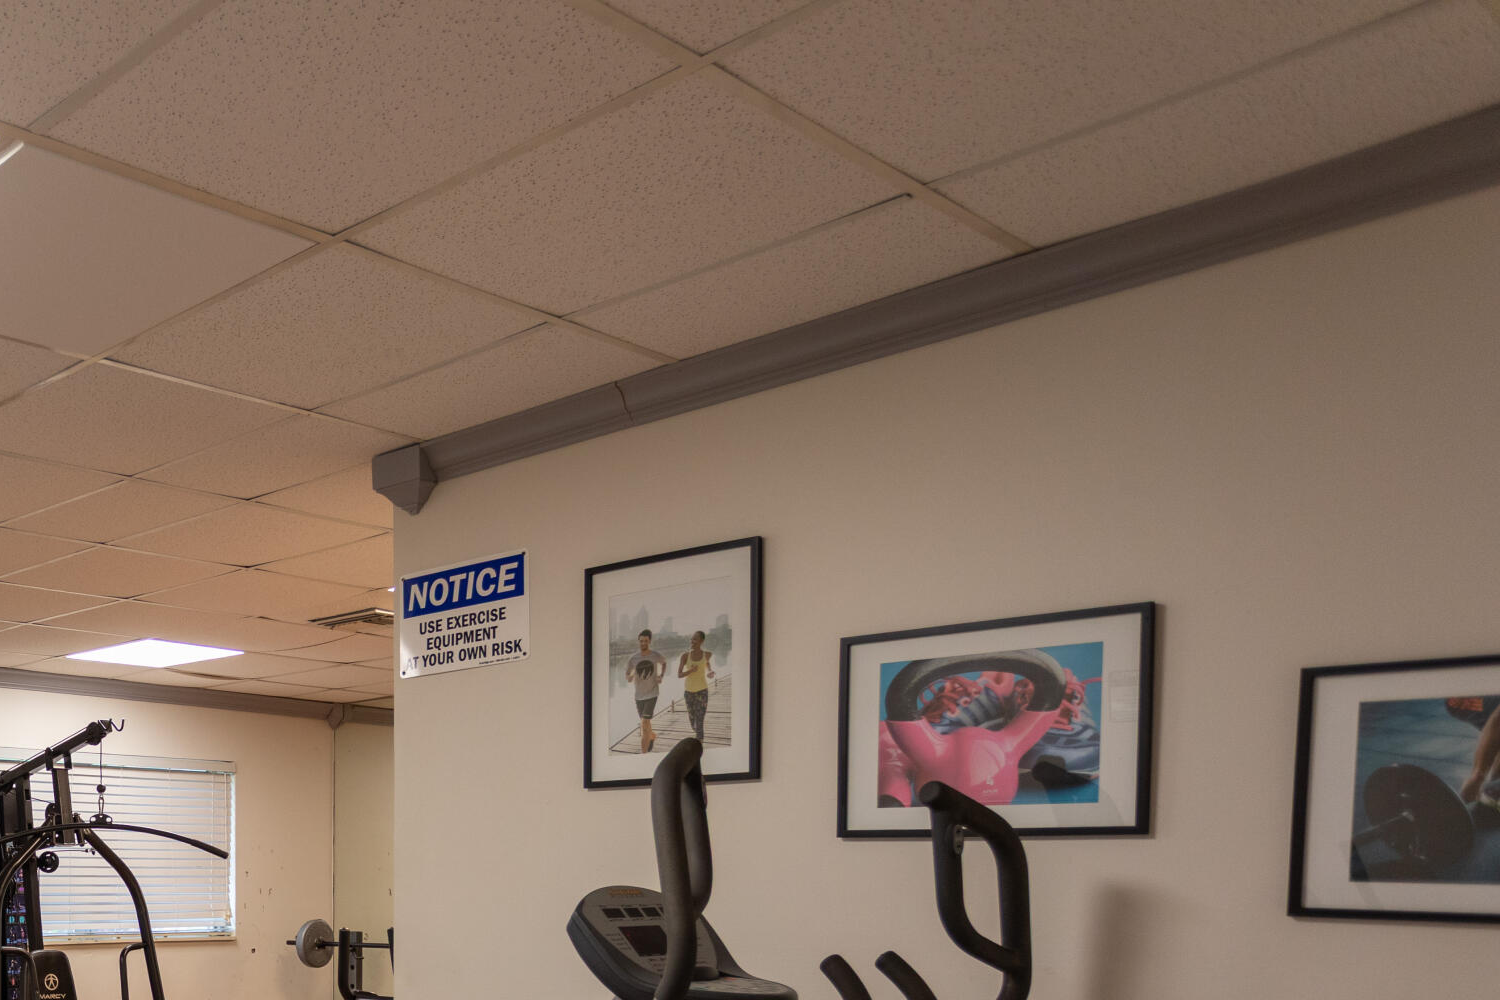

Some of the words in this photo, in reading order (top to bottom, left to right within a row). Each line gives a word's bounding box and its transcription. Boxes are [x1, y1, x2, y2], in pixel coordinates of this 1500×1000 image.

[408, 561, 519, 612] NOTICE
[419, 619, 443, 635] USE
[446, 606, 507, 631] EXERCISE
[426, 626, 498, 651] EQUIPMENT
[405, 656, 419, 671] AT
[422, 651, 454, 668] YOUR
[458, 645, 487, 662] OWN
[491, 638, 523, 657] RISK
